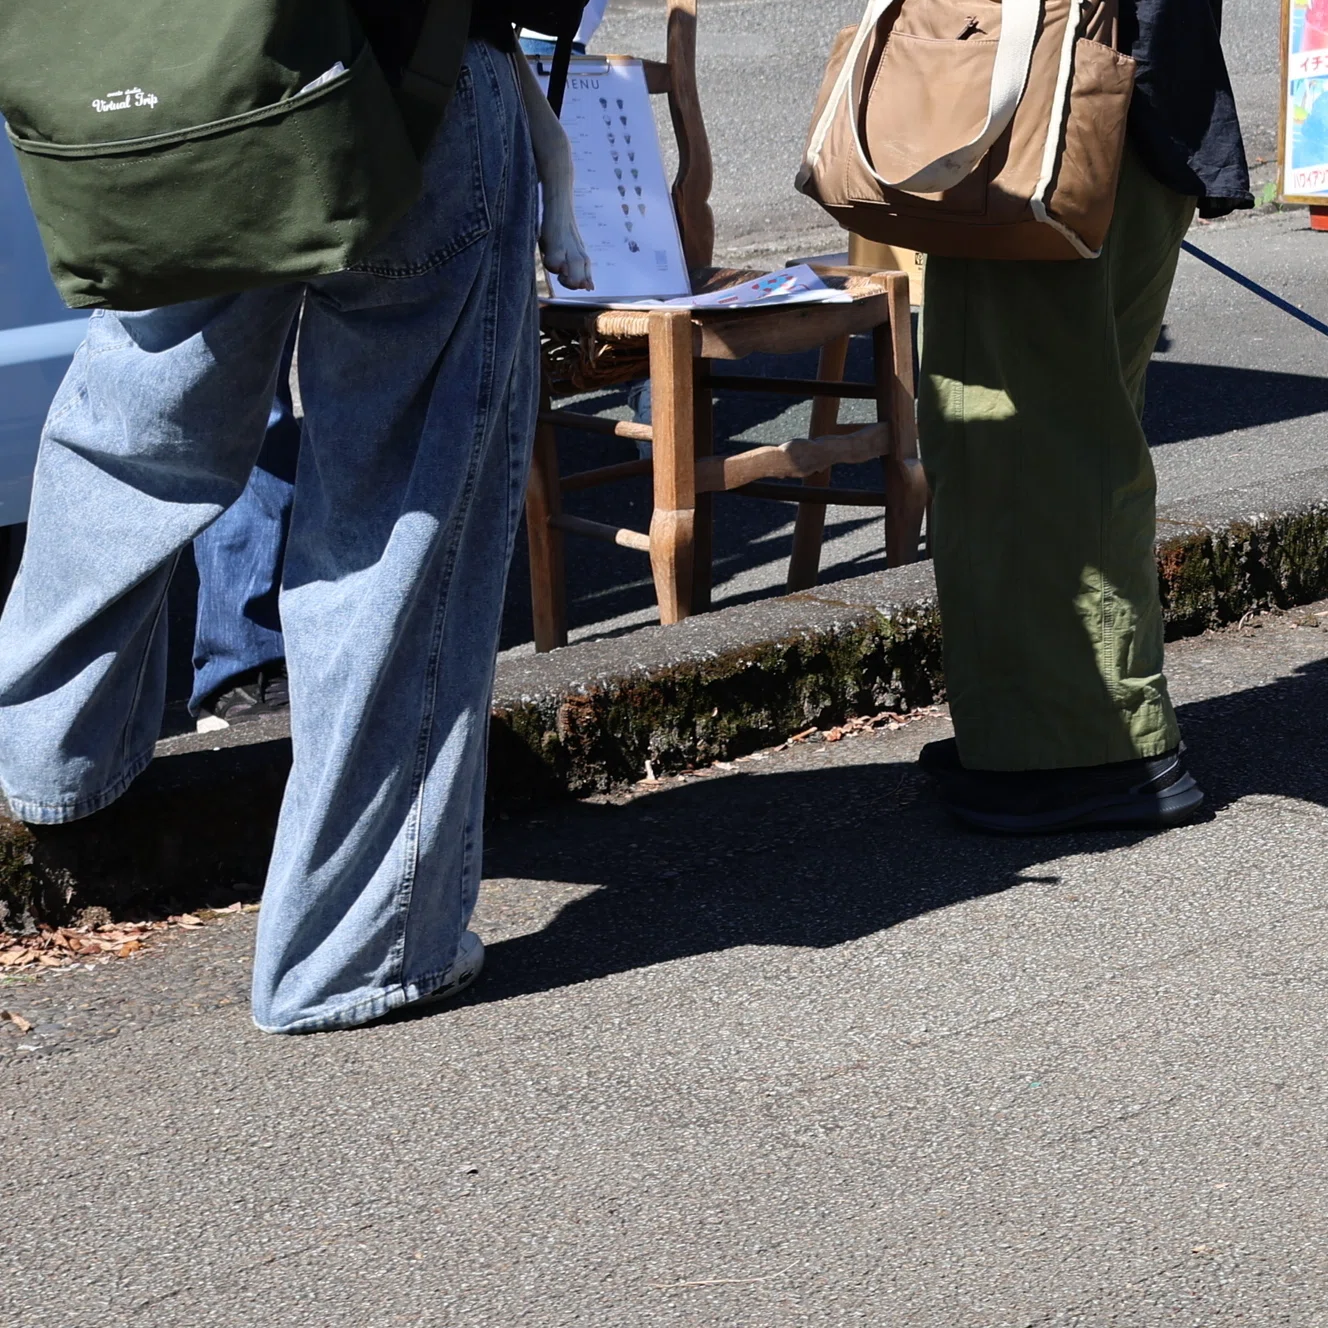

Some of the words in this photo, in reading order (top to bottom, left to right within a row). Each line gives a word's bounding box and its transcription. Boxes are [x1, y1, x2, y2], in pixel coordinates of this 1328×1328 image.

[567, 78, 600, 89] ENU
[92, 95, 131, 112] Virtual
[135, 92, 158, 109] Trip
